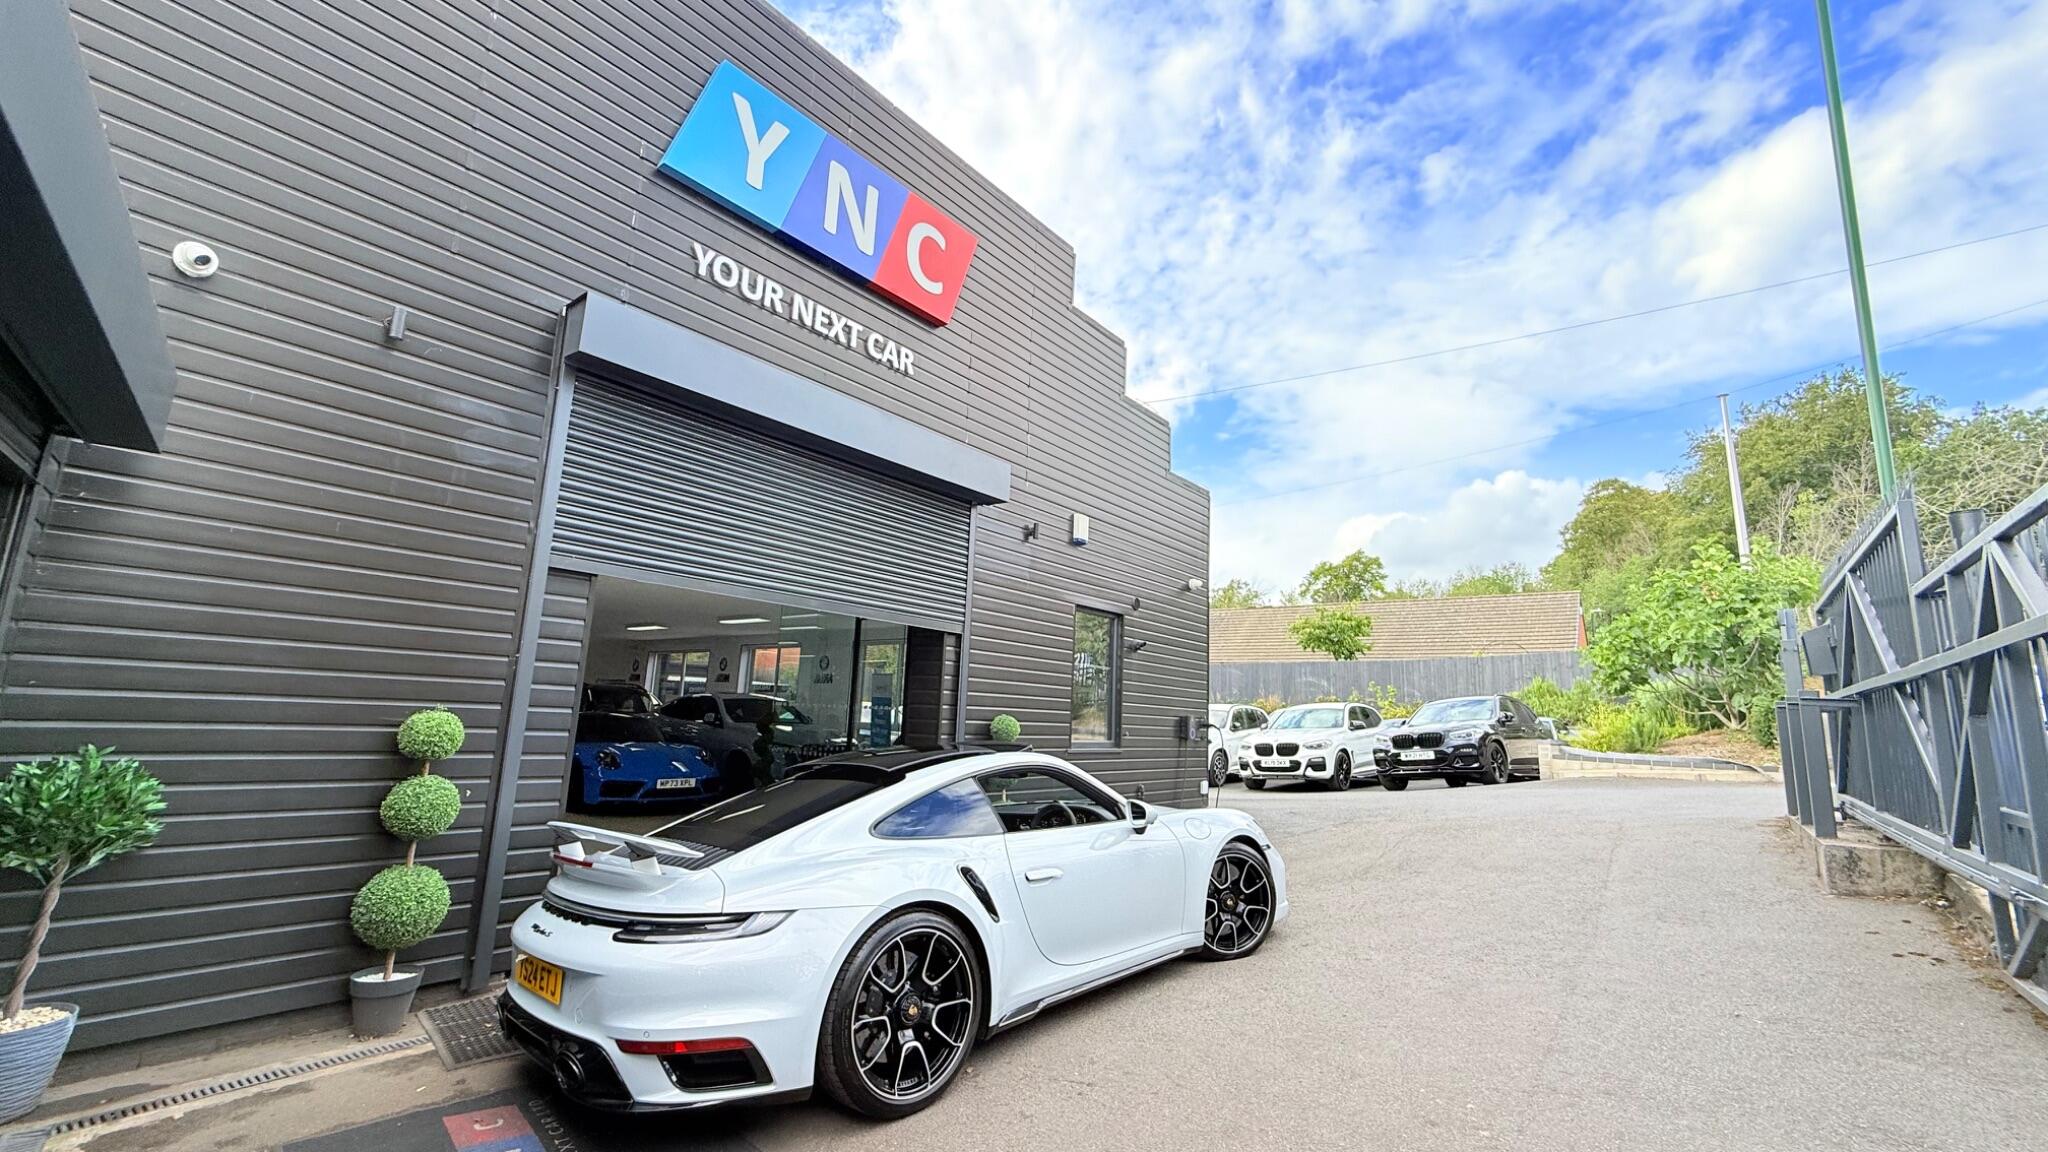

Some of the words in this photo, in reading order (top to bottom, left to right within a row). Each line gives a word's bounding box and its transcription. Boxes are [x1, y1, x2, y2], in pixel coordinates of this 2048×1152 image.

[732, 92, 946, 295] YNC
[692, 241, 784, 314] YOUR
[791, 293, 863, 348] NEXT
[866, 332, 915, 376] CAR
